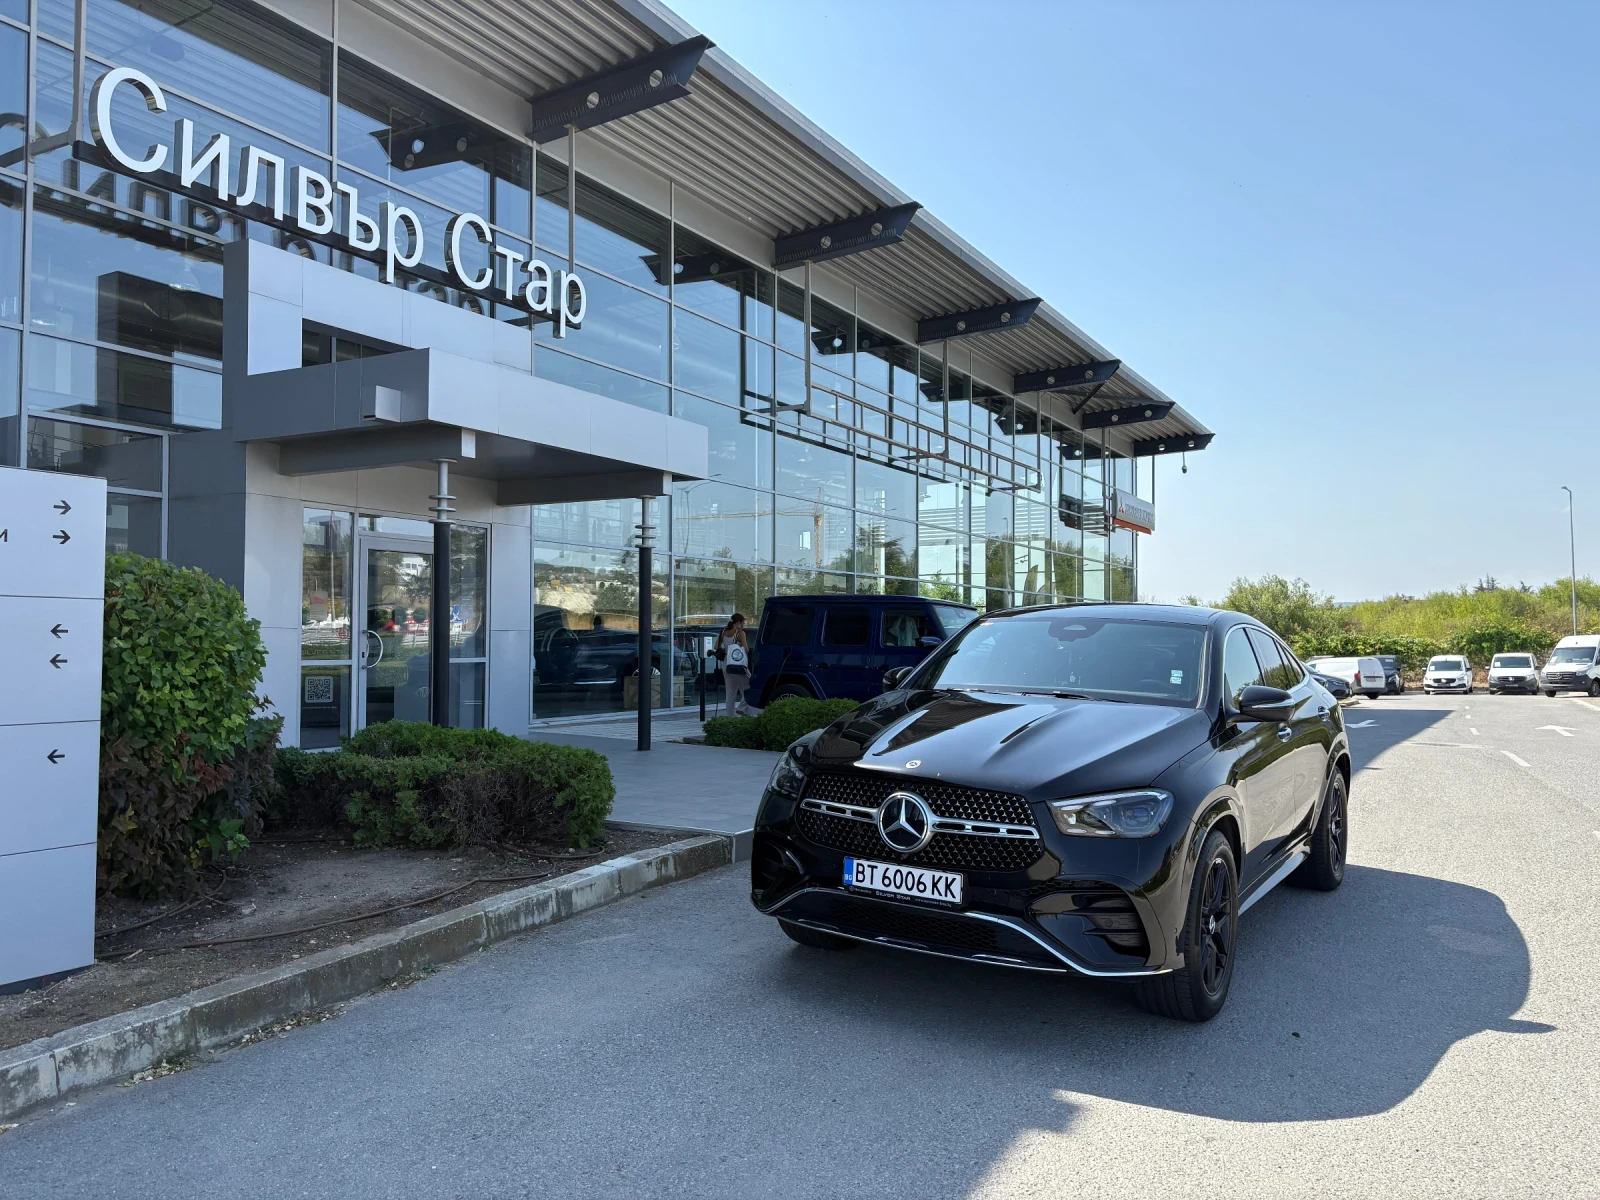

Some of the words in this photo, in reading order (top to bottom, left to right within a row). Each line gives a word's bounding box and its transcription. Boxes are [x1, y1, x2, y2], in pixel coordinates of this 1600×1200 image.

[91, 67, 424, 284] Силвър
[446, 212, 587, 338] Стар
[855, 862, 878, 885] BT
[881, 867, 927, 893] 6006
[931, 874, 957, 899] KK
